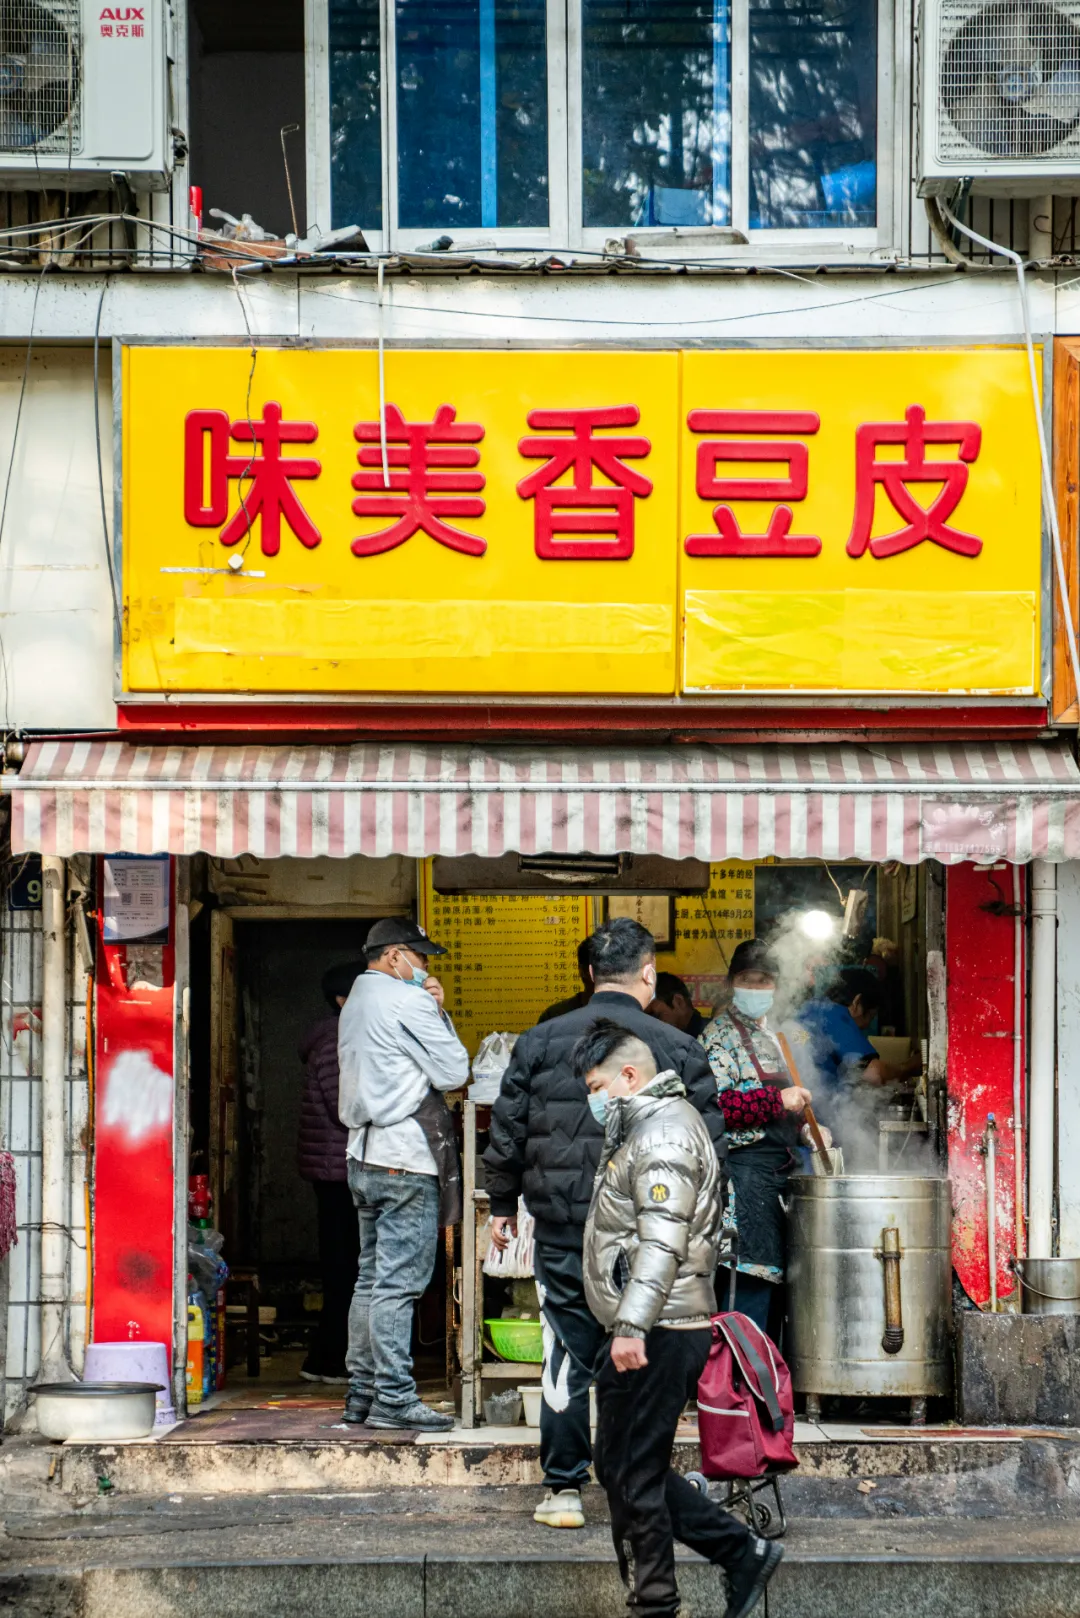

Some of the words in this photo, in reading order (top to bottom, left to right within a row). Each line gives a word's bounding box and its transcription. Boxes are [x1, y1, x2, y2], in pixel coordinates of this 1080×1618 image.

[99, 7, 145, 21] AUX
[100, 24, 144, 38] 奥克斯
[184, 400, 983, 561] 味美香豆皮
